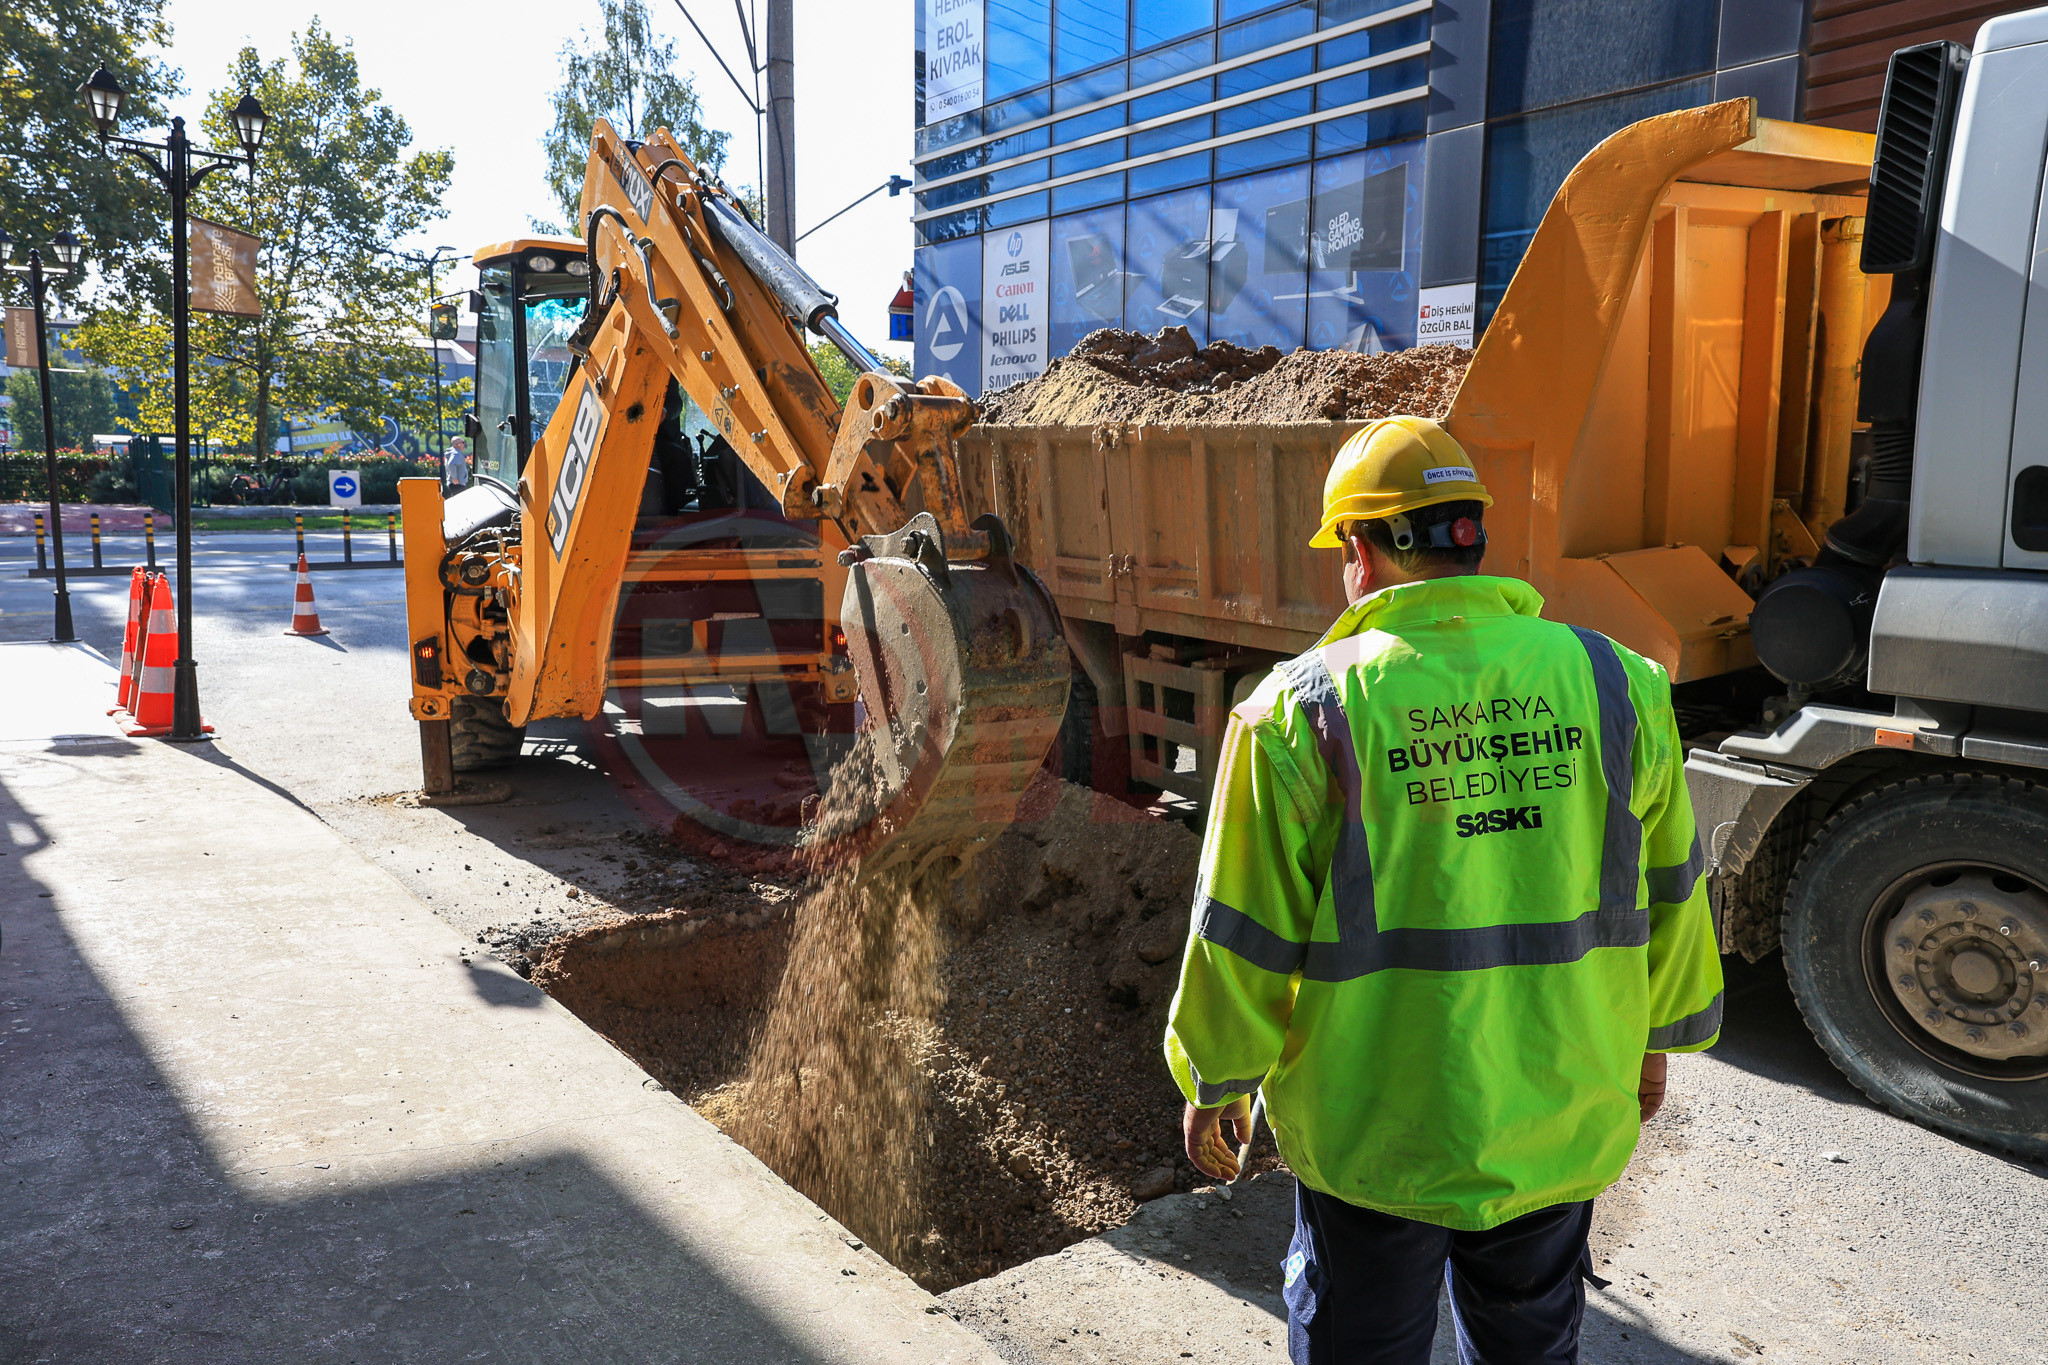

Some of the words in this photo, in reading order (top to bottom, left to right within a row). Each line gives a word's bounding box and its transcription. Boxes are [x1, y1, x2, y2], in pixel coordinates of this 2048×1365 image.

[938, 18, 973, 51] EROL
[930, 42, 981, 81] KIVRAK
[1328, 212, 1349, 231] QLED
[1328, 218, 1360, 242] GAMING
[1008, 232, 1022, 257] hp
[1328, 227, 1365, 254] MONITOR
[211, 229, 225, 284] pencere
[1000, 260, 1030, 277] ASUS
[996, 281, 1034, 298] Canon
[999, 302, 1030, 323] DELL
[1431, 305, 1444, 318] DİŞ
[1445, 301, 1474, 315] HEKİMİ
[992, 327, 1036, 347] PHILIPS
[1420, 319, 1451, 333] ÖZGÜR
[1453, 320, 1472, 331] BAL
[990, 353, 1037, 367] lenovo
[553, 390, 600, 552] JCB
[1427, 471, 1444, 479] ÖNCE
[1408, 695, 1555, 733] SAKARYA
[1387, 723, 1583, 774] BÜYÜKŞEHİR
[1406, 757, 1577, 806] BELEDİYESİ
